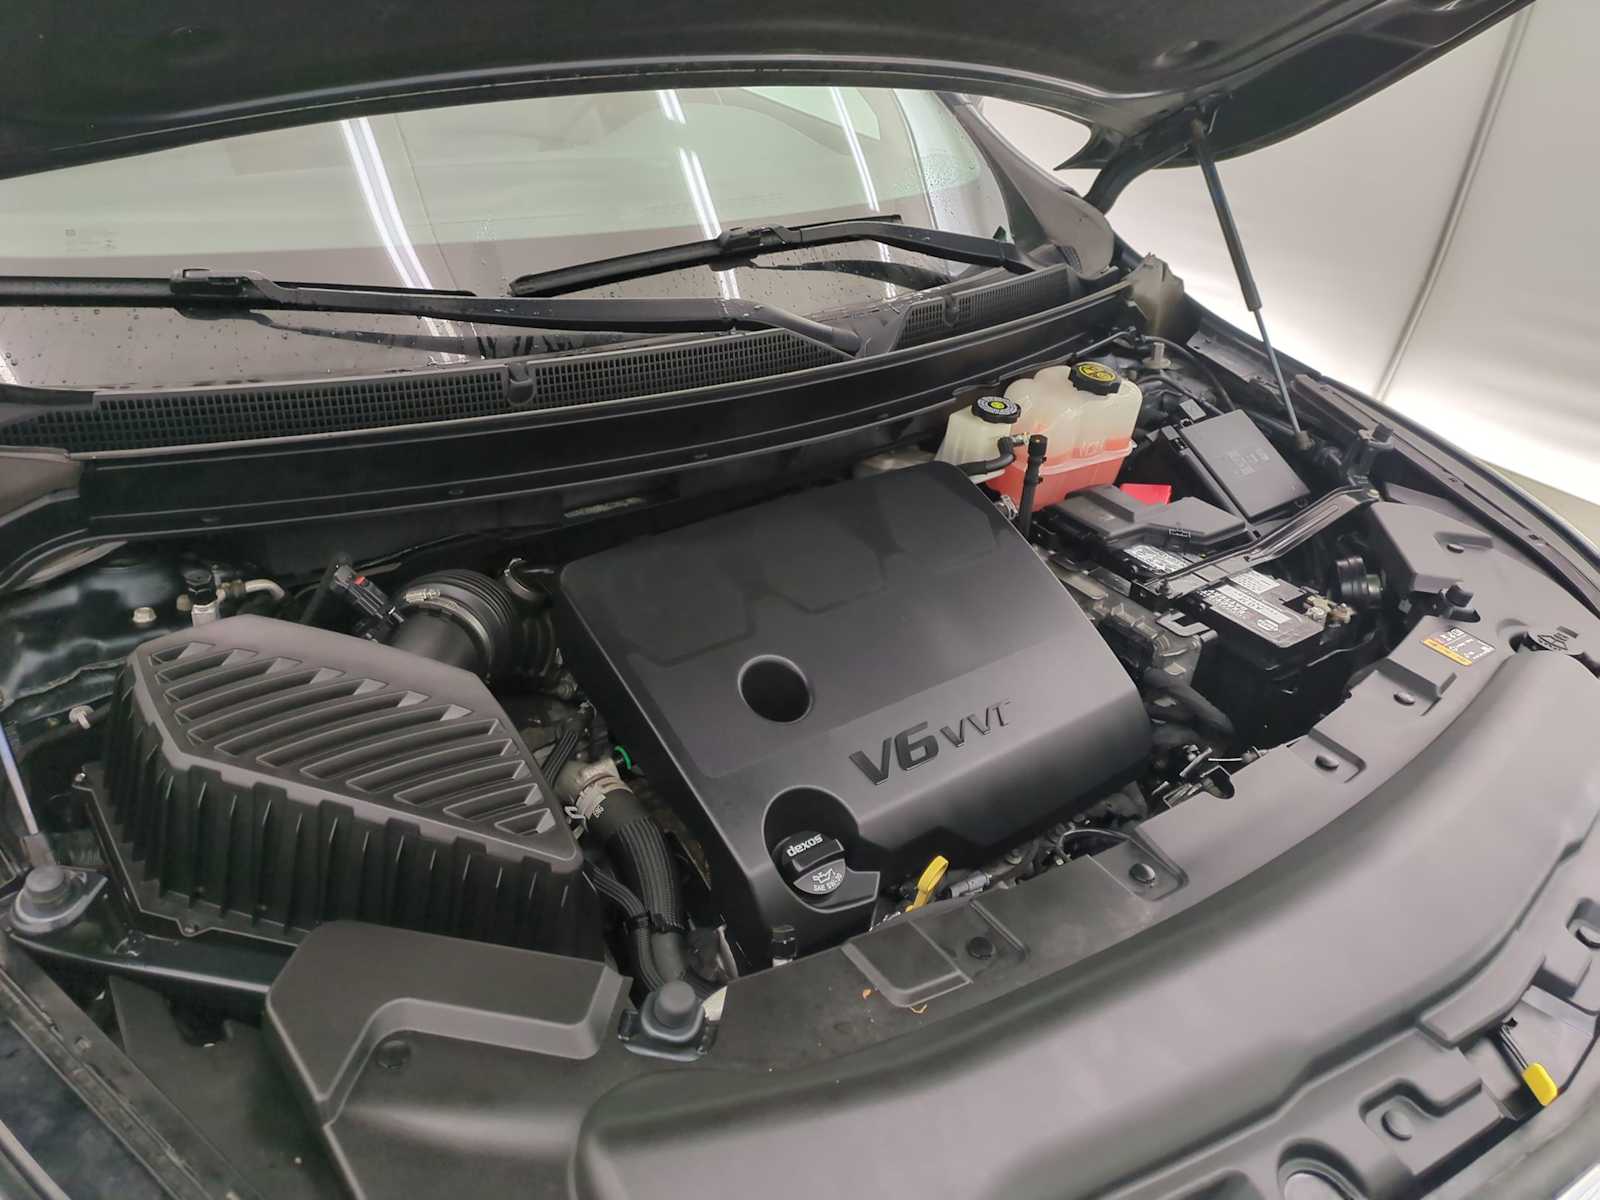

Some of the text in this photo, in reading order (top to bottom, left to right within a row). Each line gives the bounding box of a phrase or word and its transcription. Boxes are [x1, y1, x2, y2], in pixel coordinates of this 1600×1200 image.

[849, 697, 1014, 786] V6 VVT
[786, 833, 824, 857] dexos
